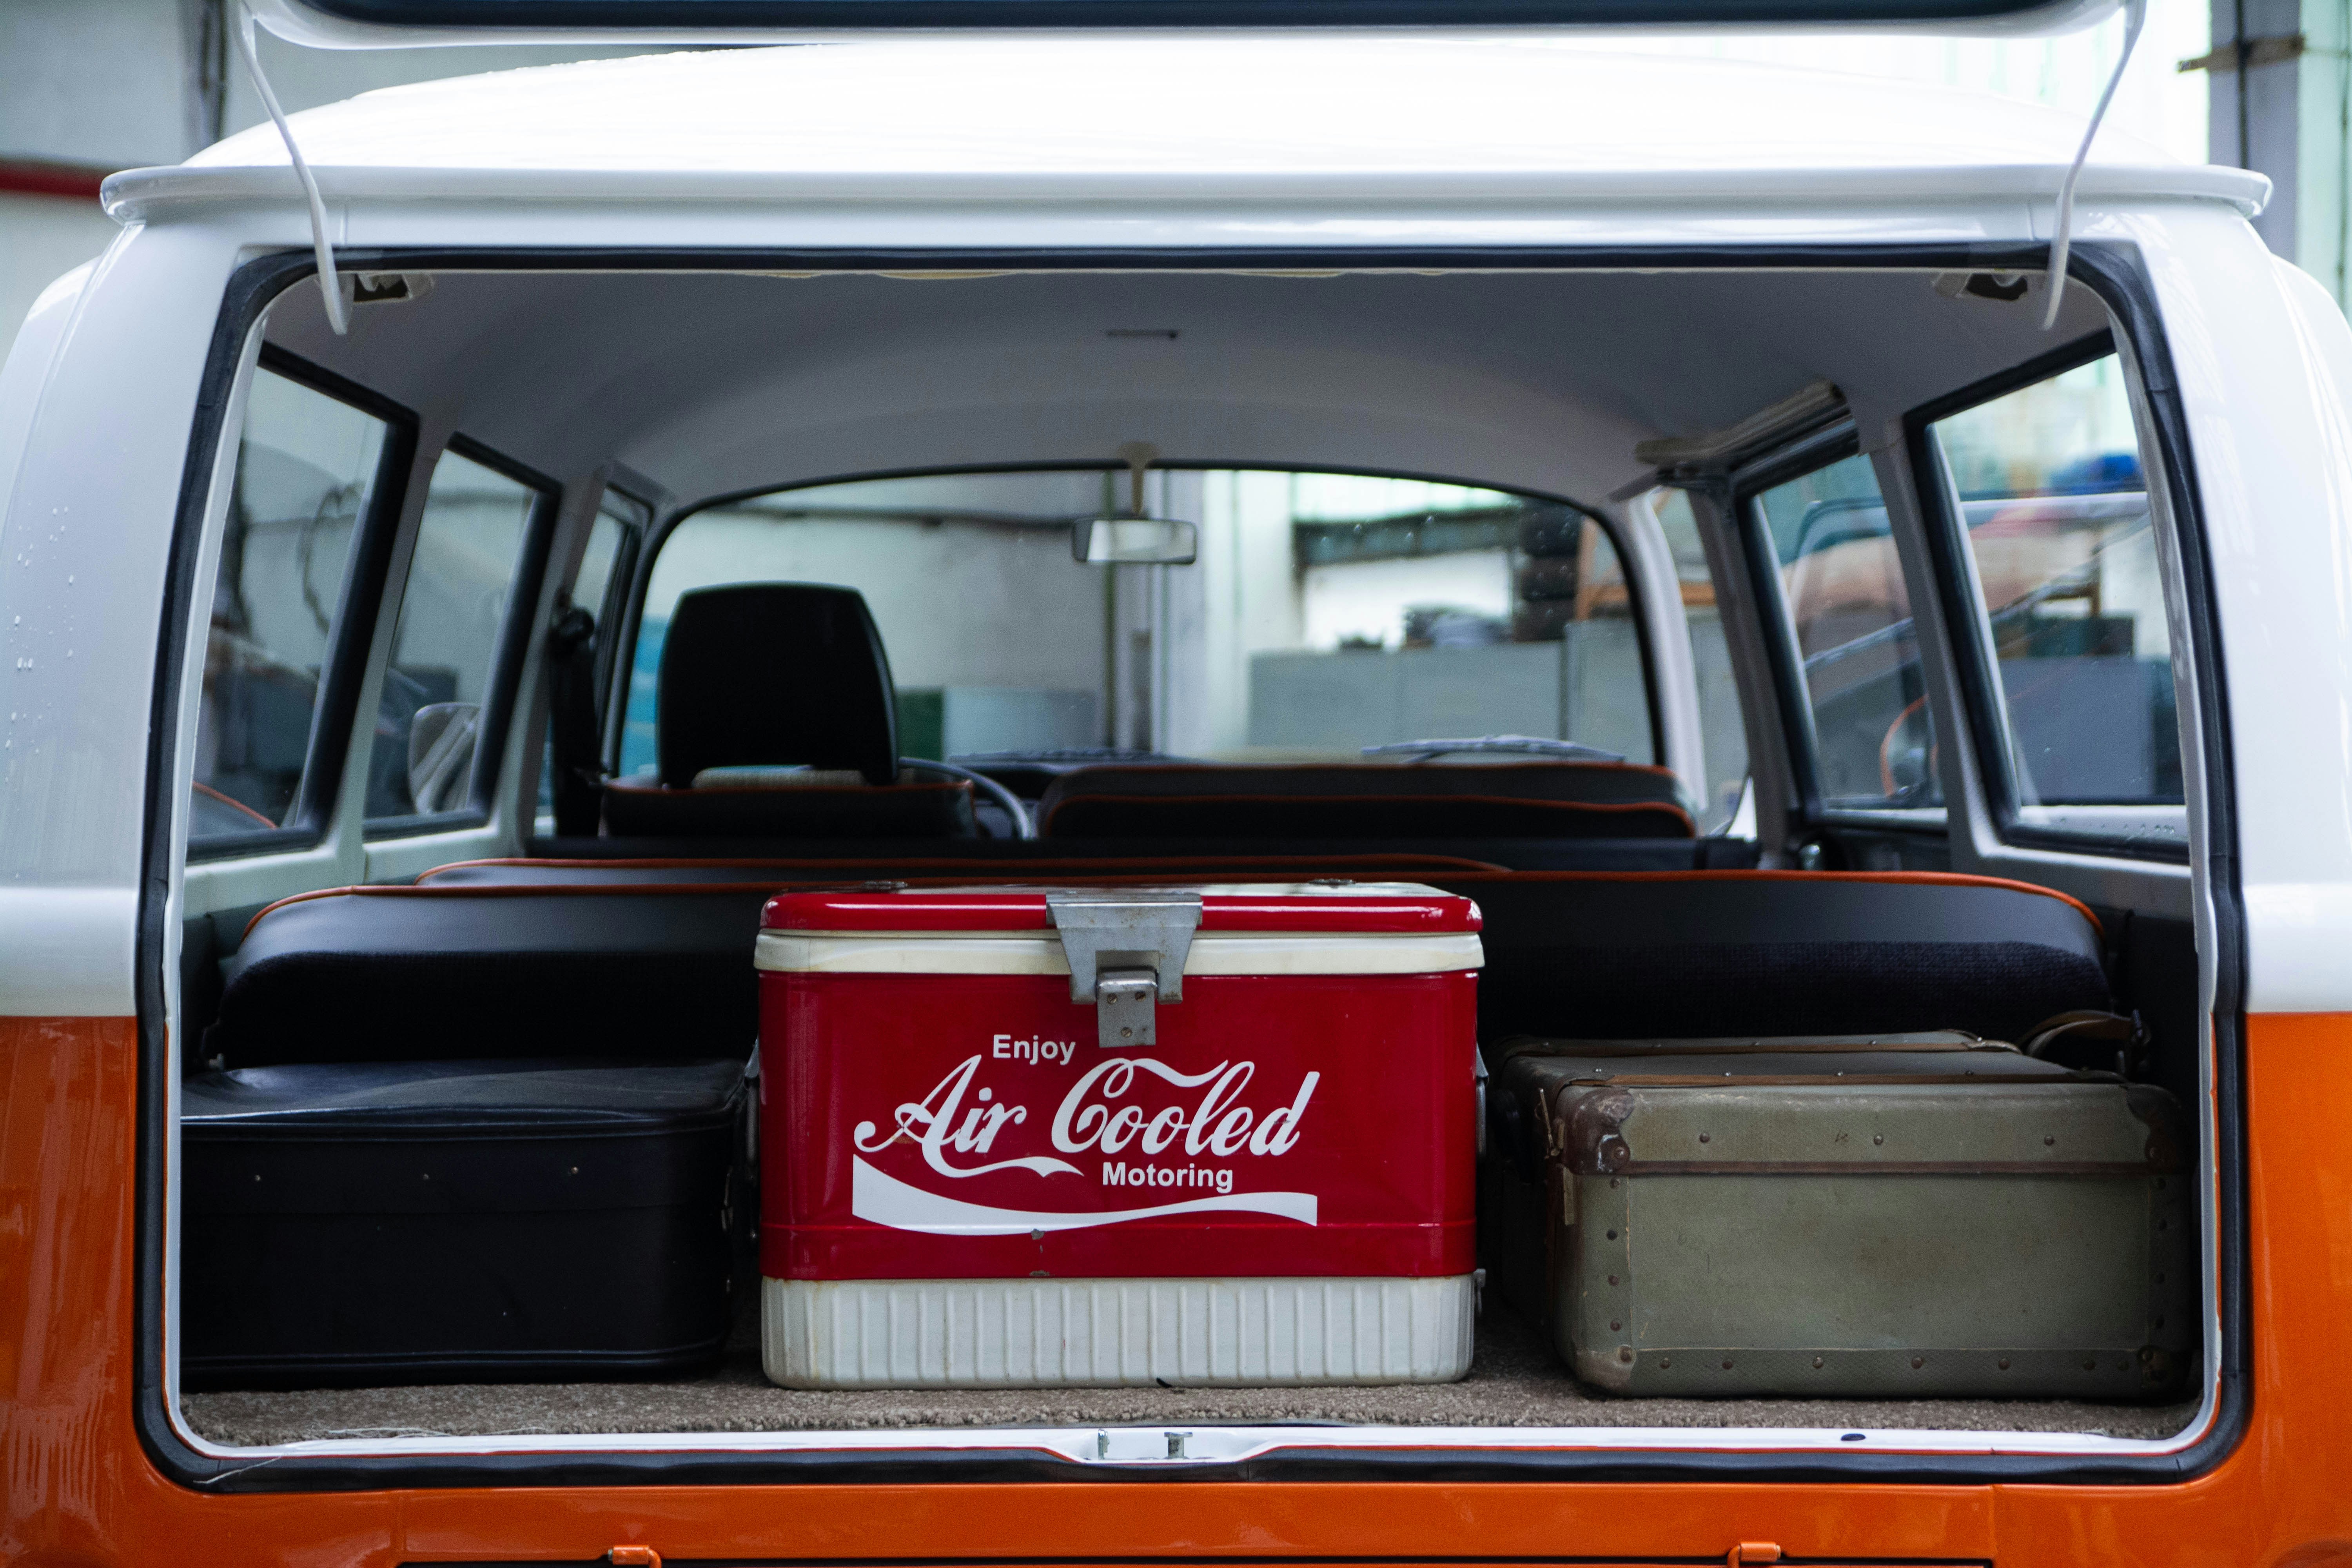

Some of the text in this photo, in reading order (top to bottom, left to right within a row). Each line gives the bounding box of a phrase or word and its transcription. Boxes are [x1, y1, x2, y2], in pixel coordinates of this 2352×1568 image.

[993, 1034, 1076, 1065] Enjoy
[854, 1054, 1320, 1178] Air Cooled
[1103, 1162, 1233, 1194] Motoring
